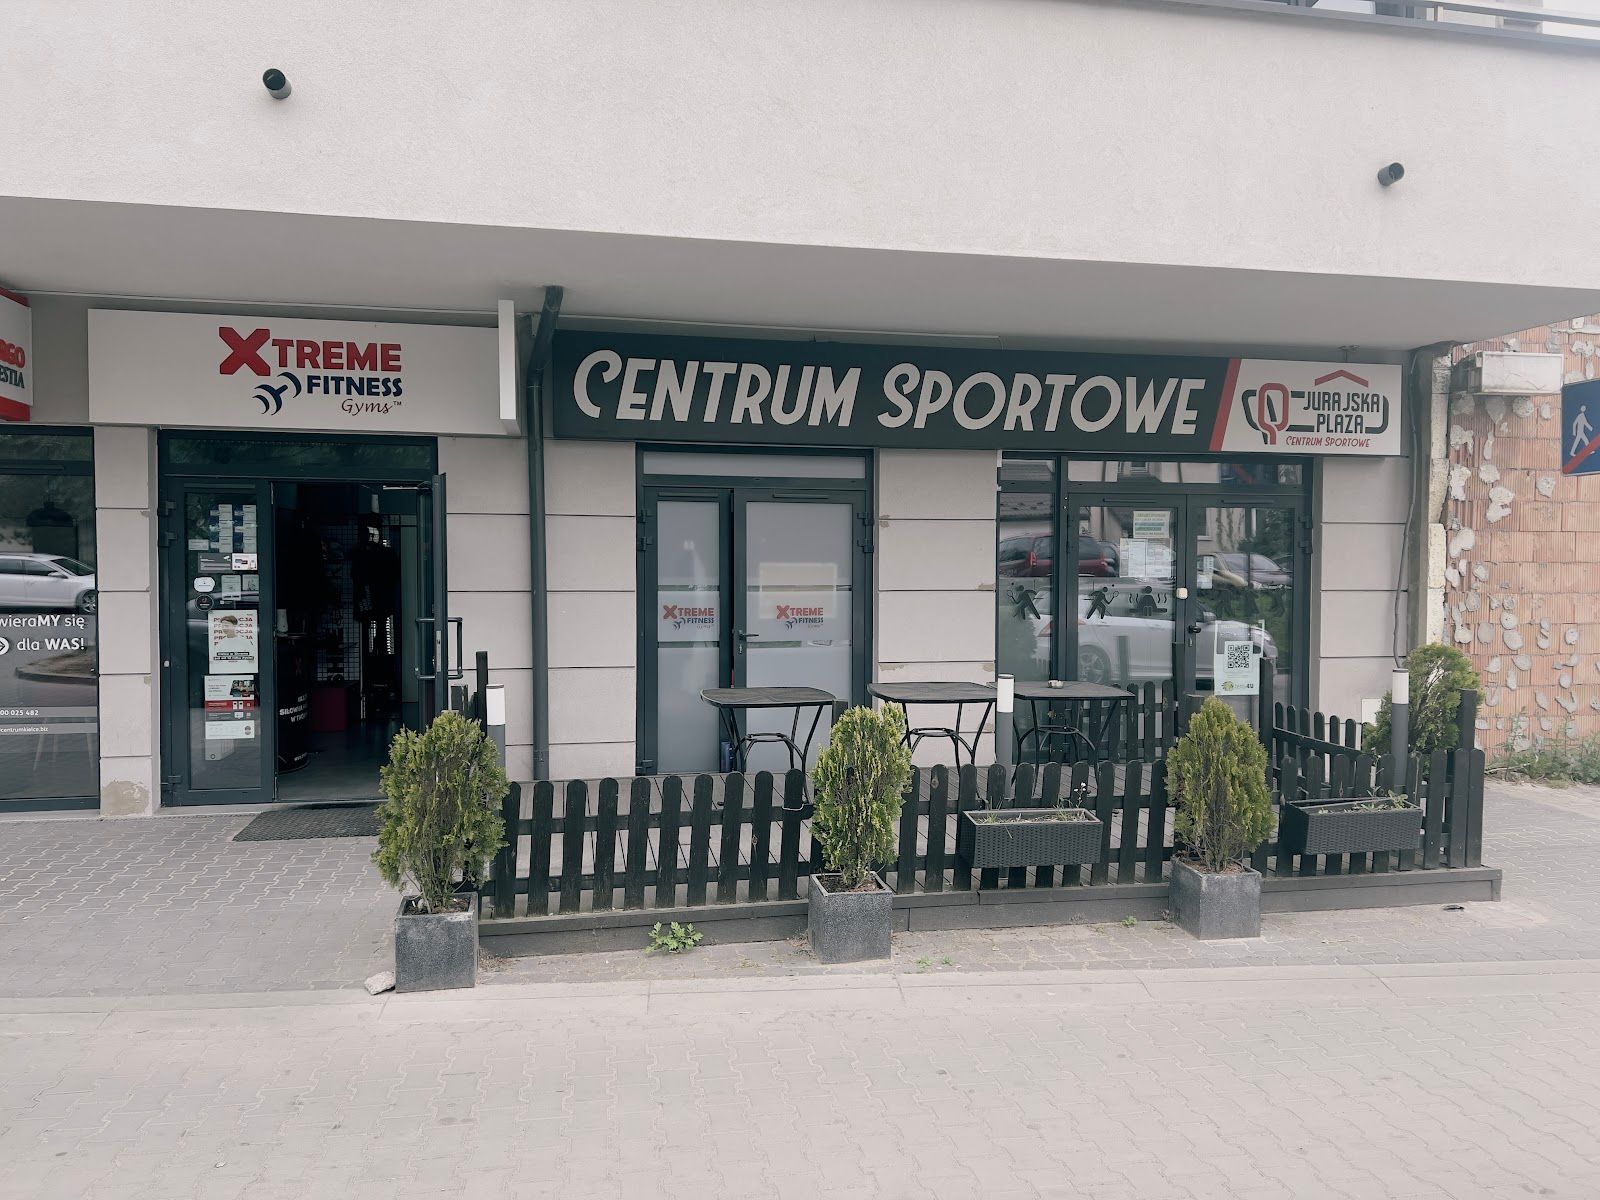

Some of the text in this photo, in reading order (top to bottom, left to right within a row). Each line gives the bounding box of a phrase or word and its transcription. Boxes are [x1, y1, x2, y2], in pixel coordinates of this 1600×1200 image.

[218, 326, 402, 376] XTREME
[307, 374, 403, 397] FITNESS
[573, 349, 1206, 435] CENTRUM SPORTOWE
[1303, 391, 1381, 413] JURAJSKA
[1316, 413, 1364, 434] PLAZA
[1285, 435, 1371, 448] CENTRUM SPORTOWE
[663, 605, 715, 620] XTREME
[776, 605, 824, 620] XTREME
[64, 614, 85, 630] się
[17, 637, 85, 651] dla WAS!
